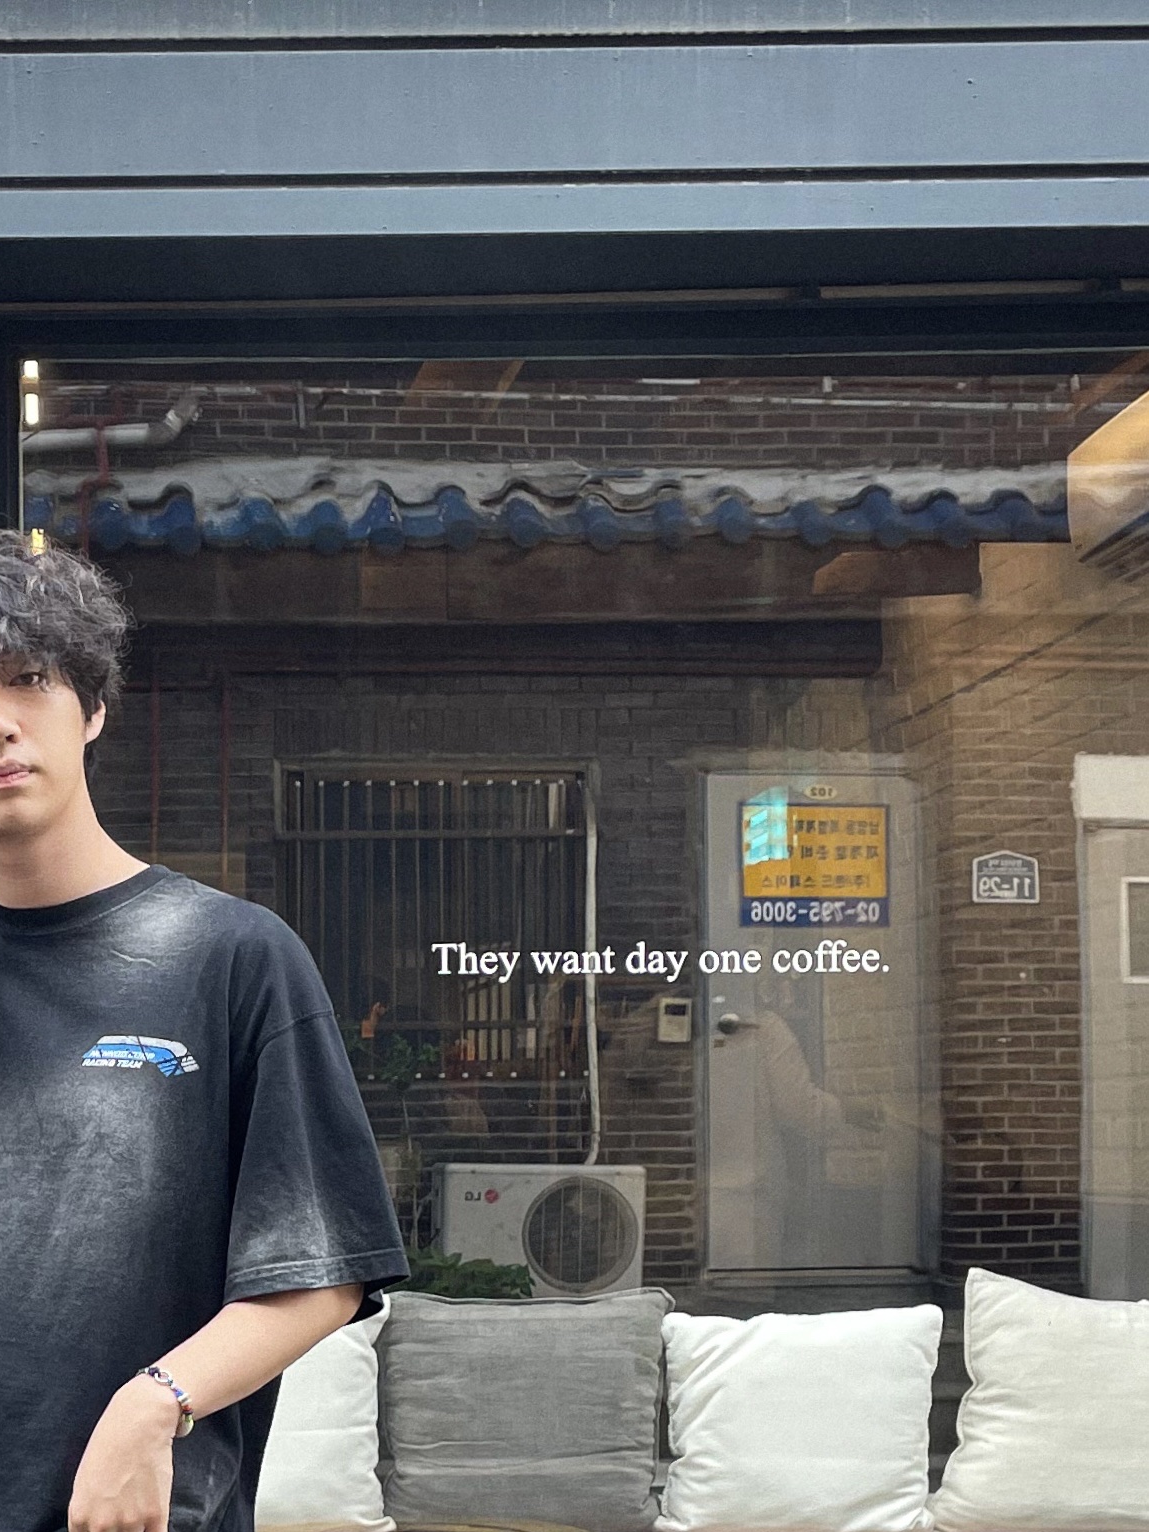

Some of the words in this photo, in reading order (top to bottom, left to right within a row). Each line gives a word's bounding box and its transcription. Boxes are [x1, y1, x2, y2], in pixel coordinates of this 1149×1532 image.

[431, 942, 521, 984] They
[530, 947, 616, 974] want
[625, 941, 689, 983] day
[698, 949, 762, 974] one
[772, 939, 890, 974] coffee.
[82, 1058, 116, 1067] RACING
[116, 1060, 143, 1069] TEAM
